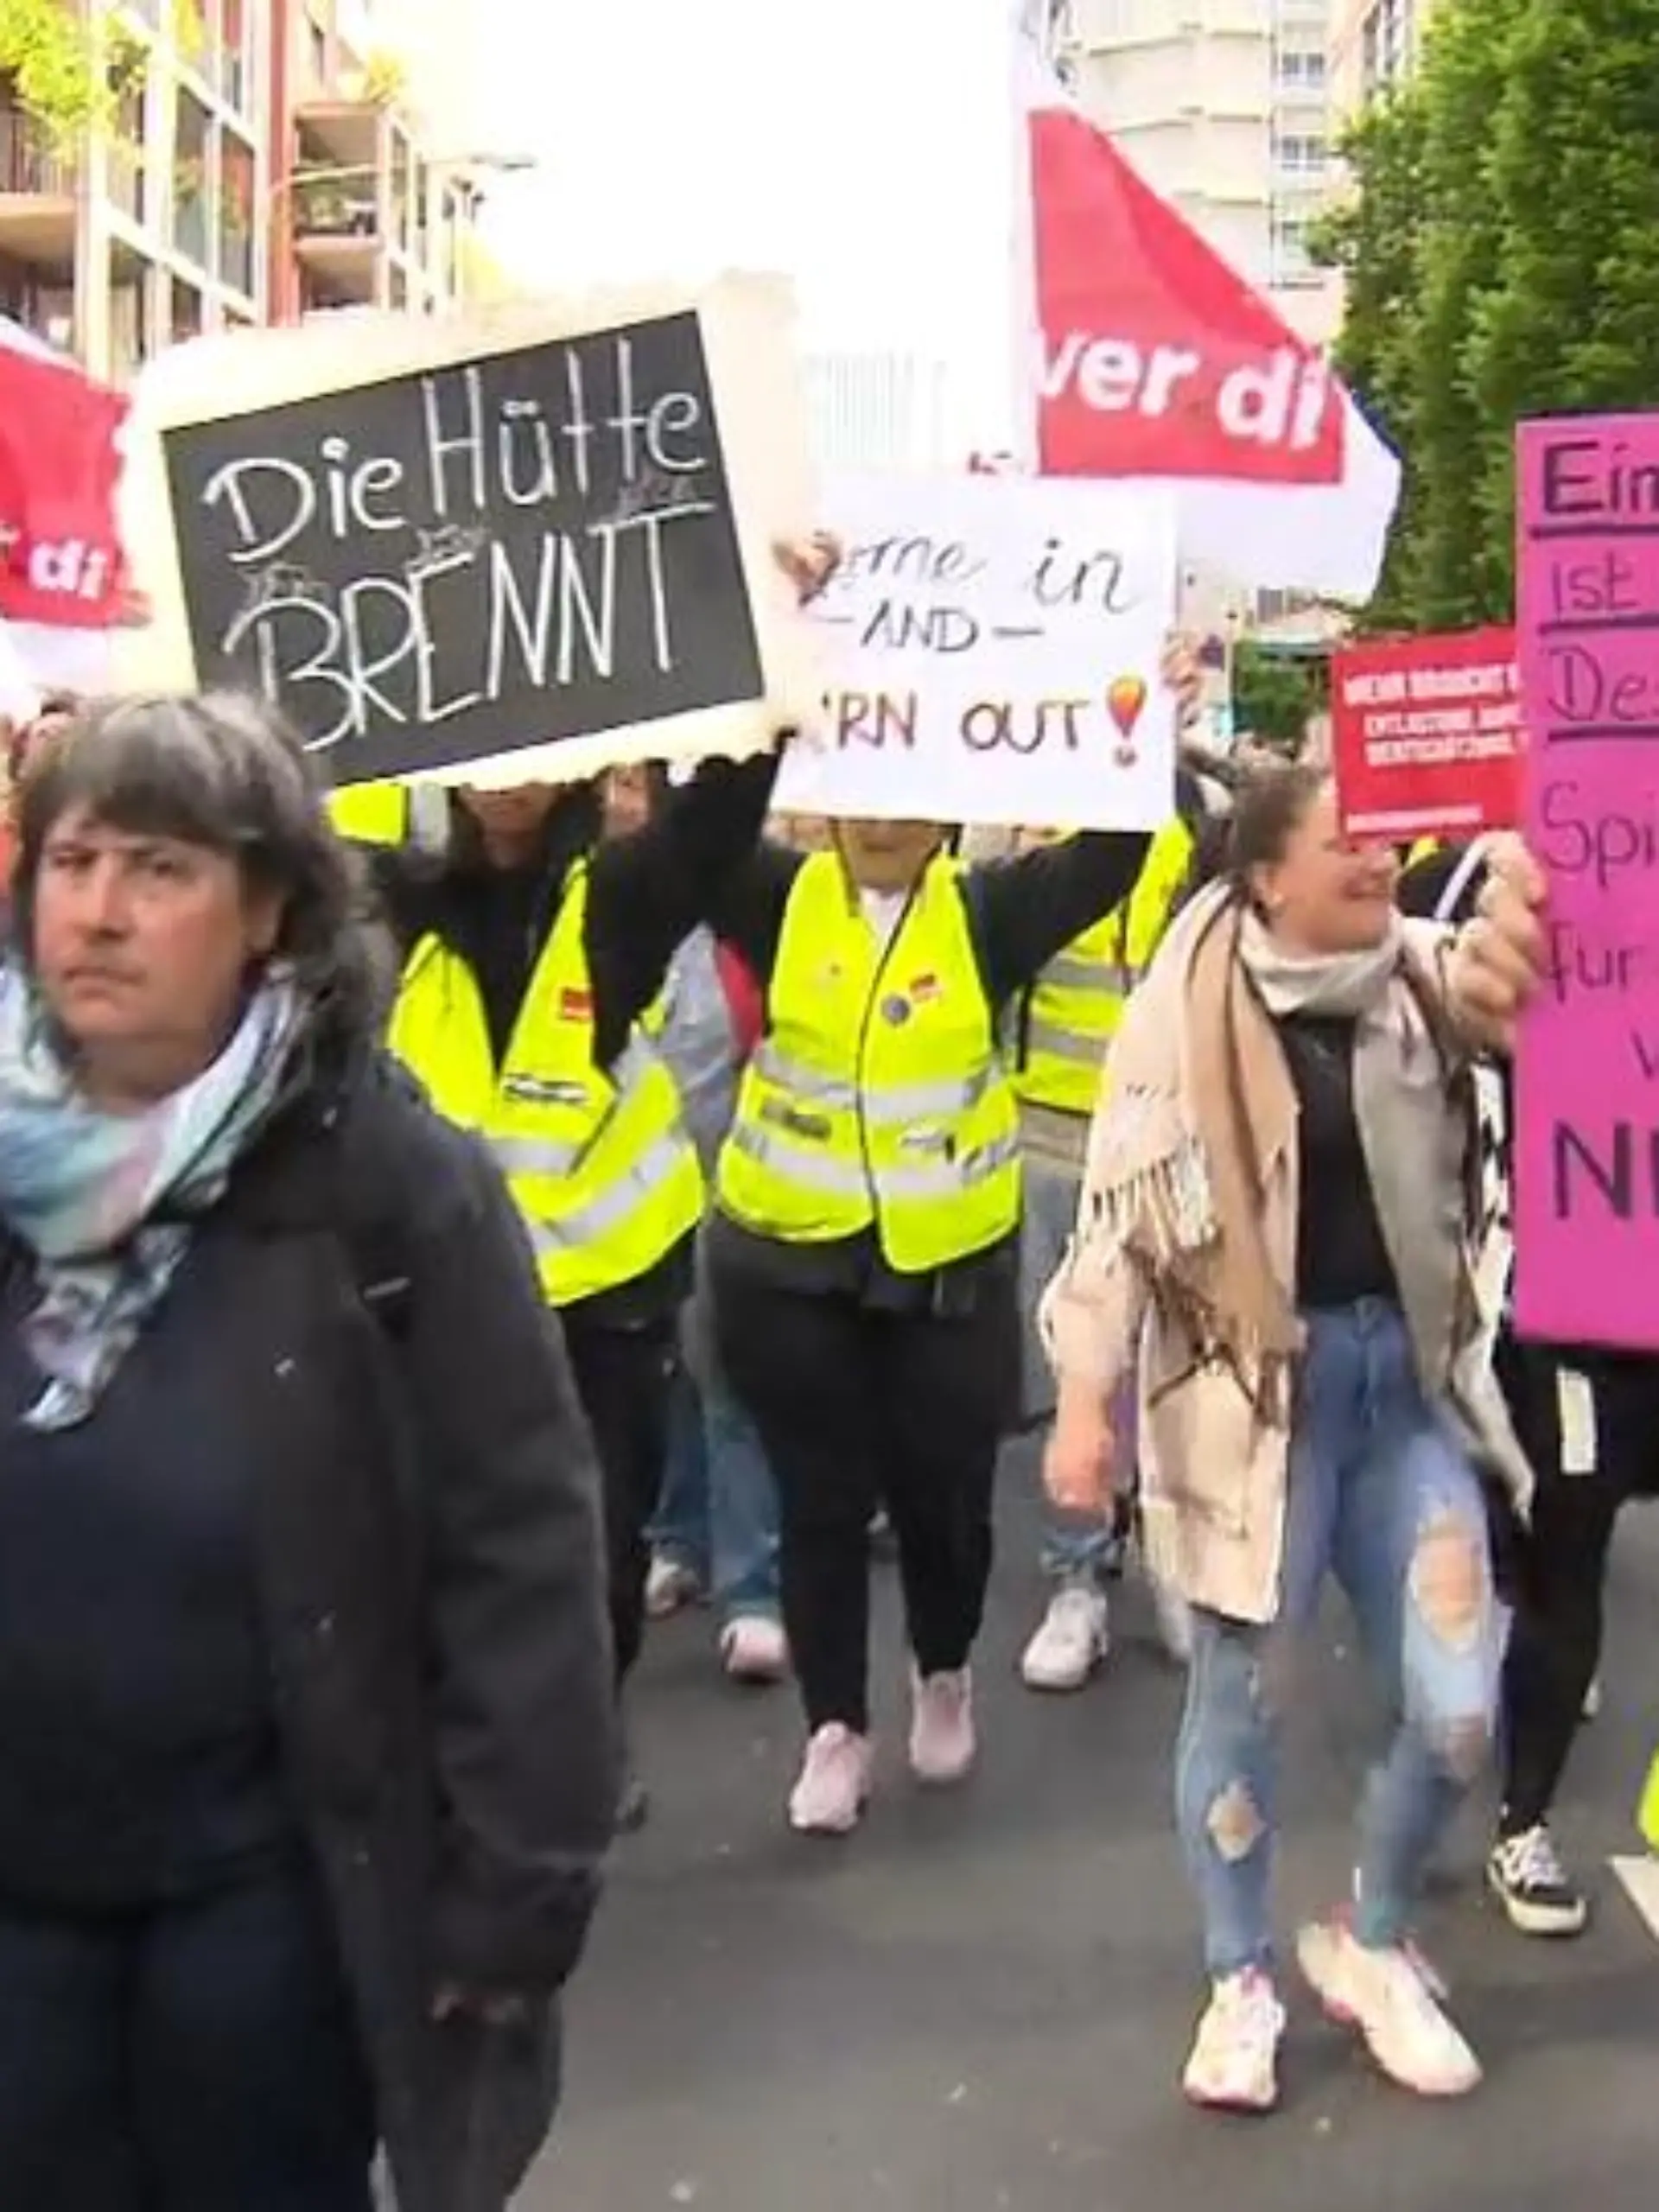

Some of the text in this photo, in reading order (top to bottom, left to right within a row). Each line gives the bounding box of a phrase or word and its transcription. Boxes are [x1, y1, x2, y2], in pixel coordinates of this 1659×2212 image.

[201, 337, 709, 562] Die Hütte
[1037, 329, 1328, 449] ver di
[223, 503, 715, 752] BRENNT
[1034, 537, 1141, 615] in
